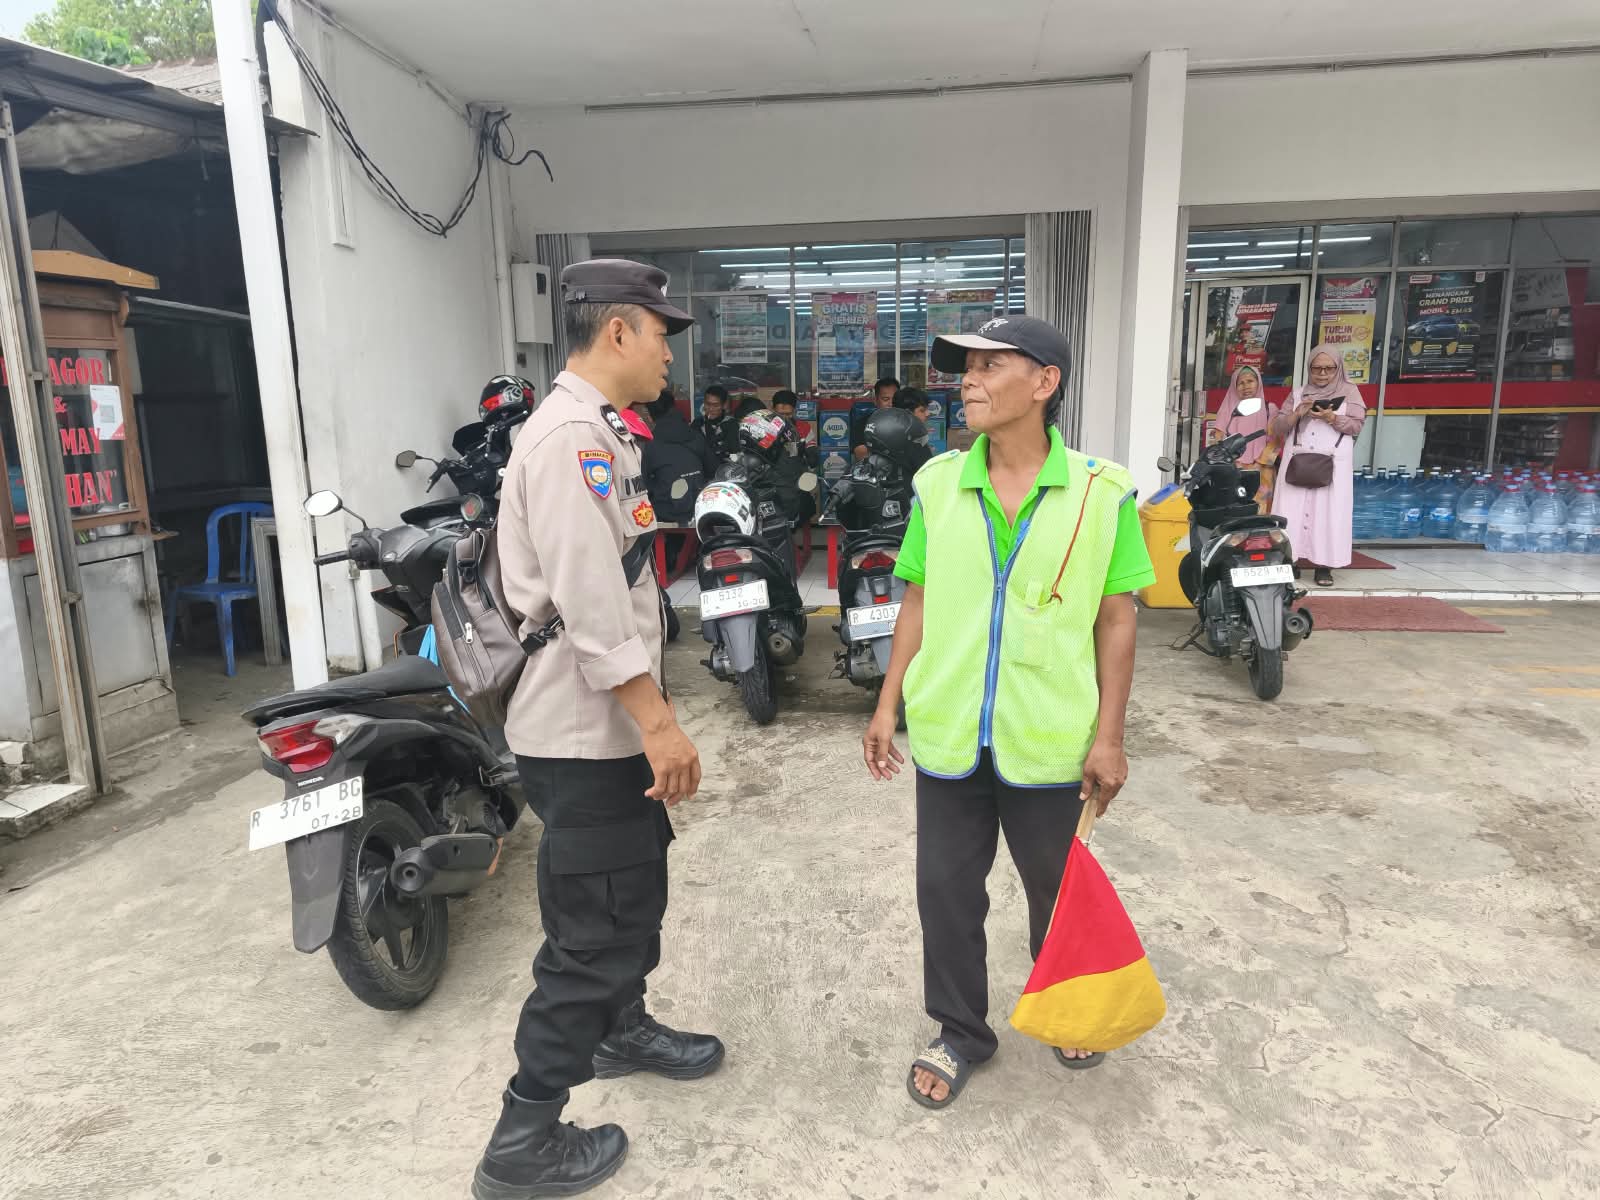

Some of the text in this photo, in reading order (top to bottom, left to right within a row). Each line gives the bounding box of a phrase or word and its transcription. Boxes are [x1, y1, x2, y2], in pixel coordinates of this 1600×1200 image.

[1419, 296, 1474, 306] GRAND PRIZE
[823, 303, 867, 314] GRATIS
[1324, 335, 1352, 344] HARGA
[852, 607, 896, 626] R 4303
[251, 811, 261, 829] R
[279, 790, 321, 820] 3761
